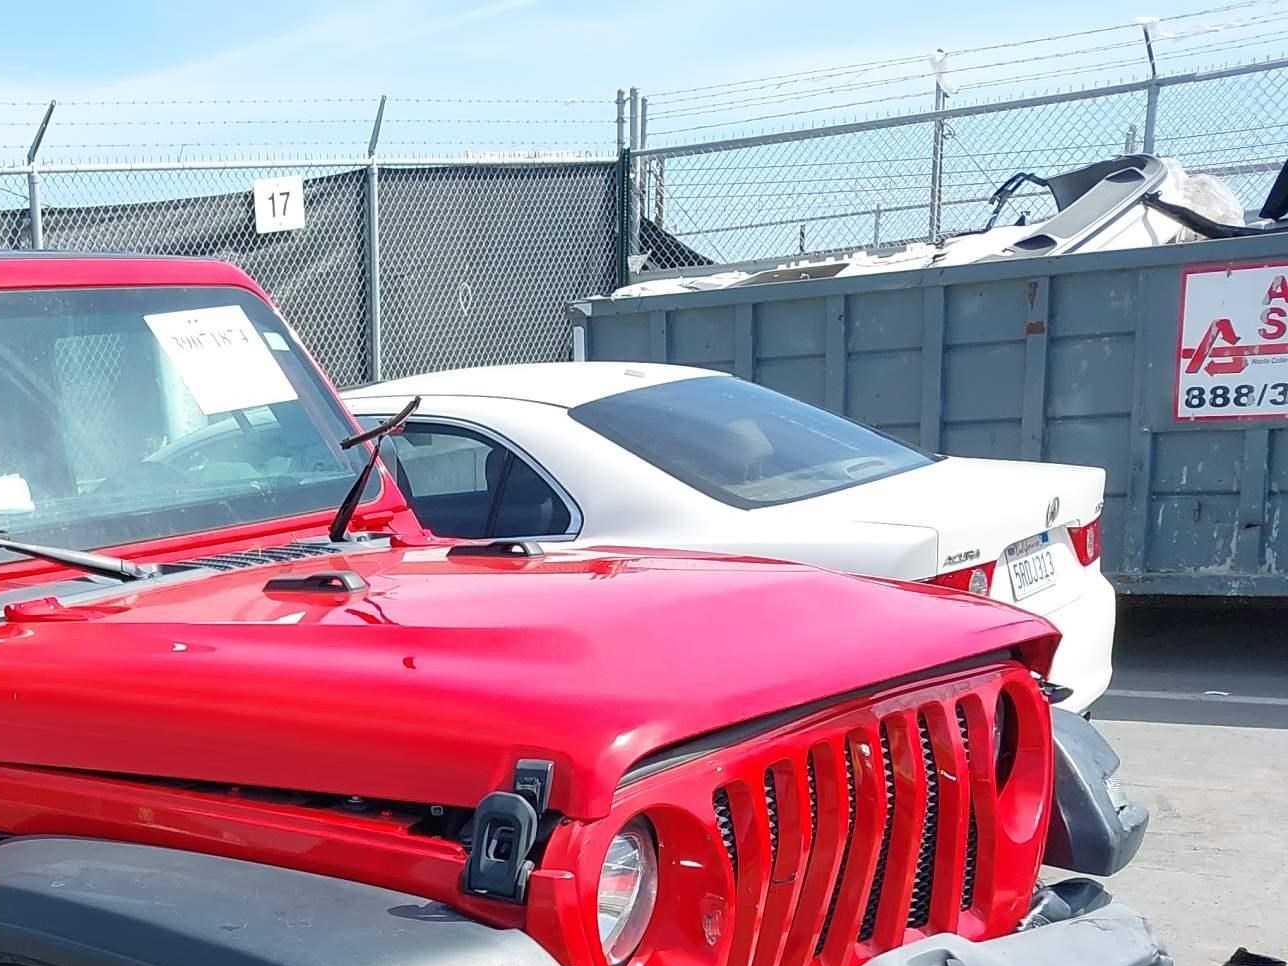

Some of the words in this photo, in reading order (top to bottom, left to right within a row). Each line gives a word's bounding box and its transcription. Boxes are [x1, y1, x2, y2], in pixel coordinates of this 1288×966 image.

[267, 191, 290, 218] 17
[942, 548, 981, 568] ACURA
[1012, 551, 1055, 590] 5RDJ313
